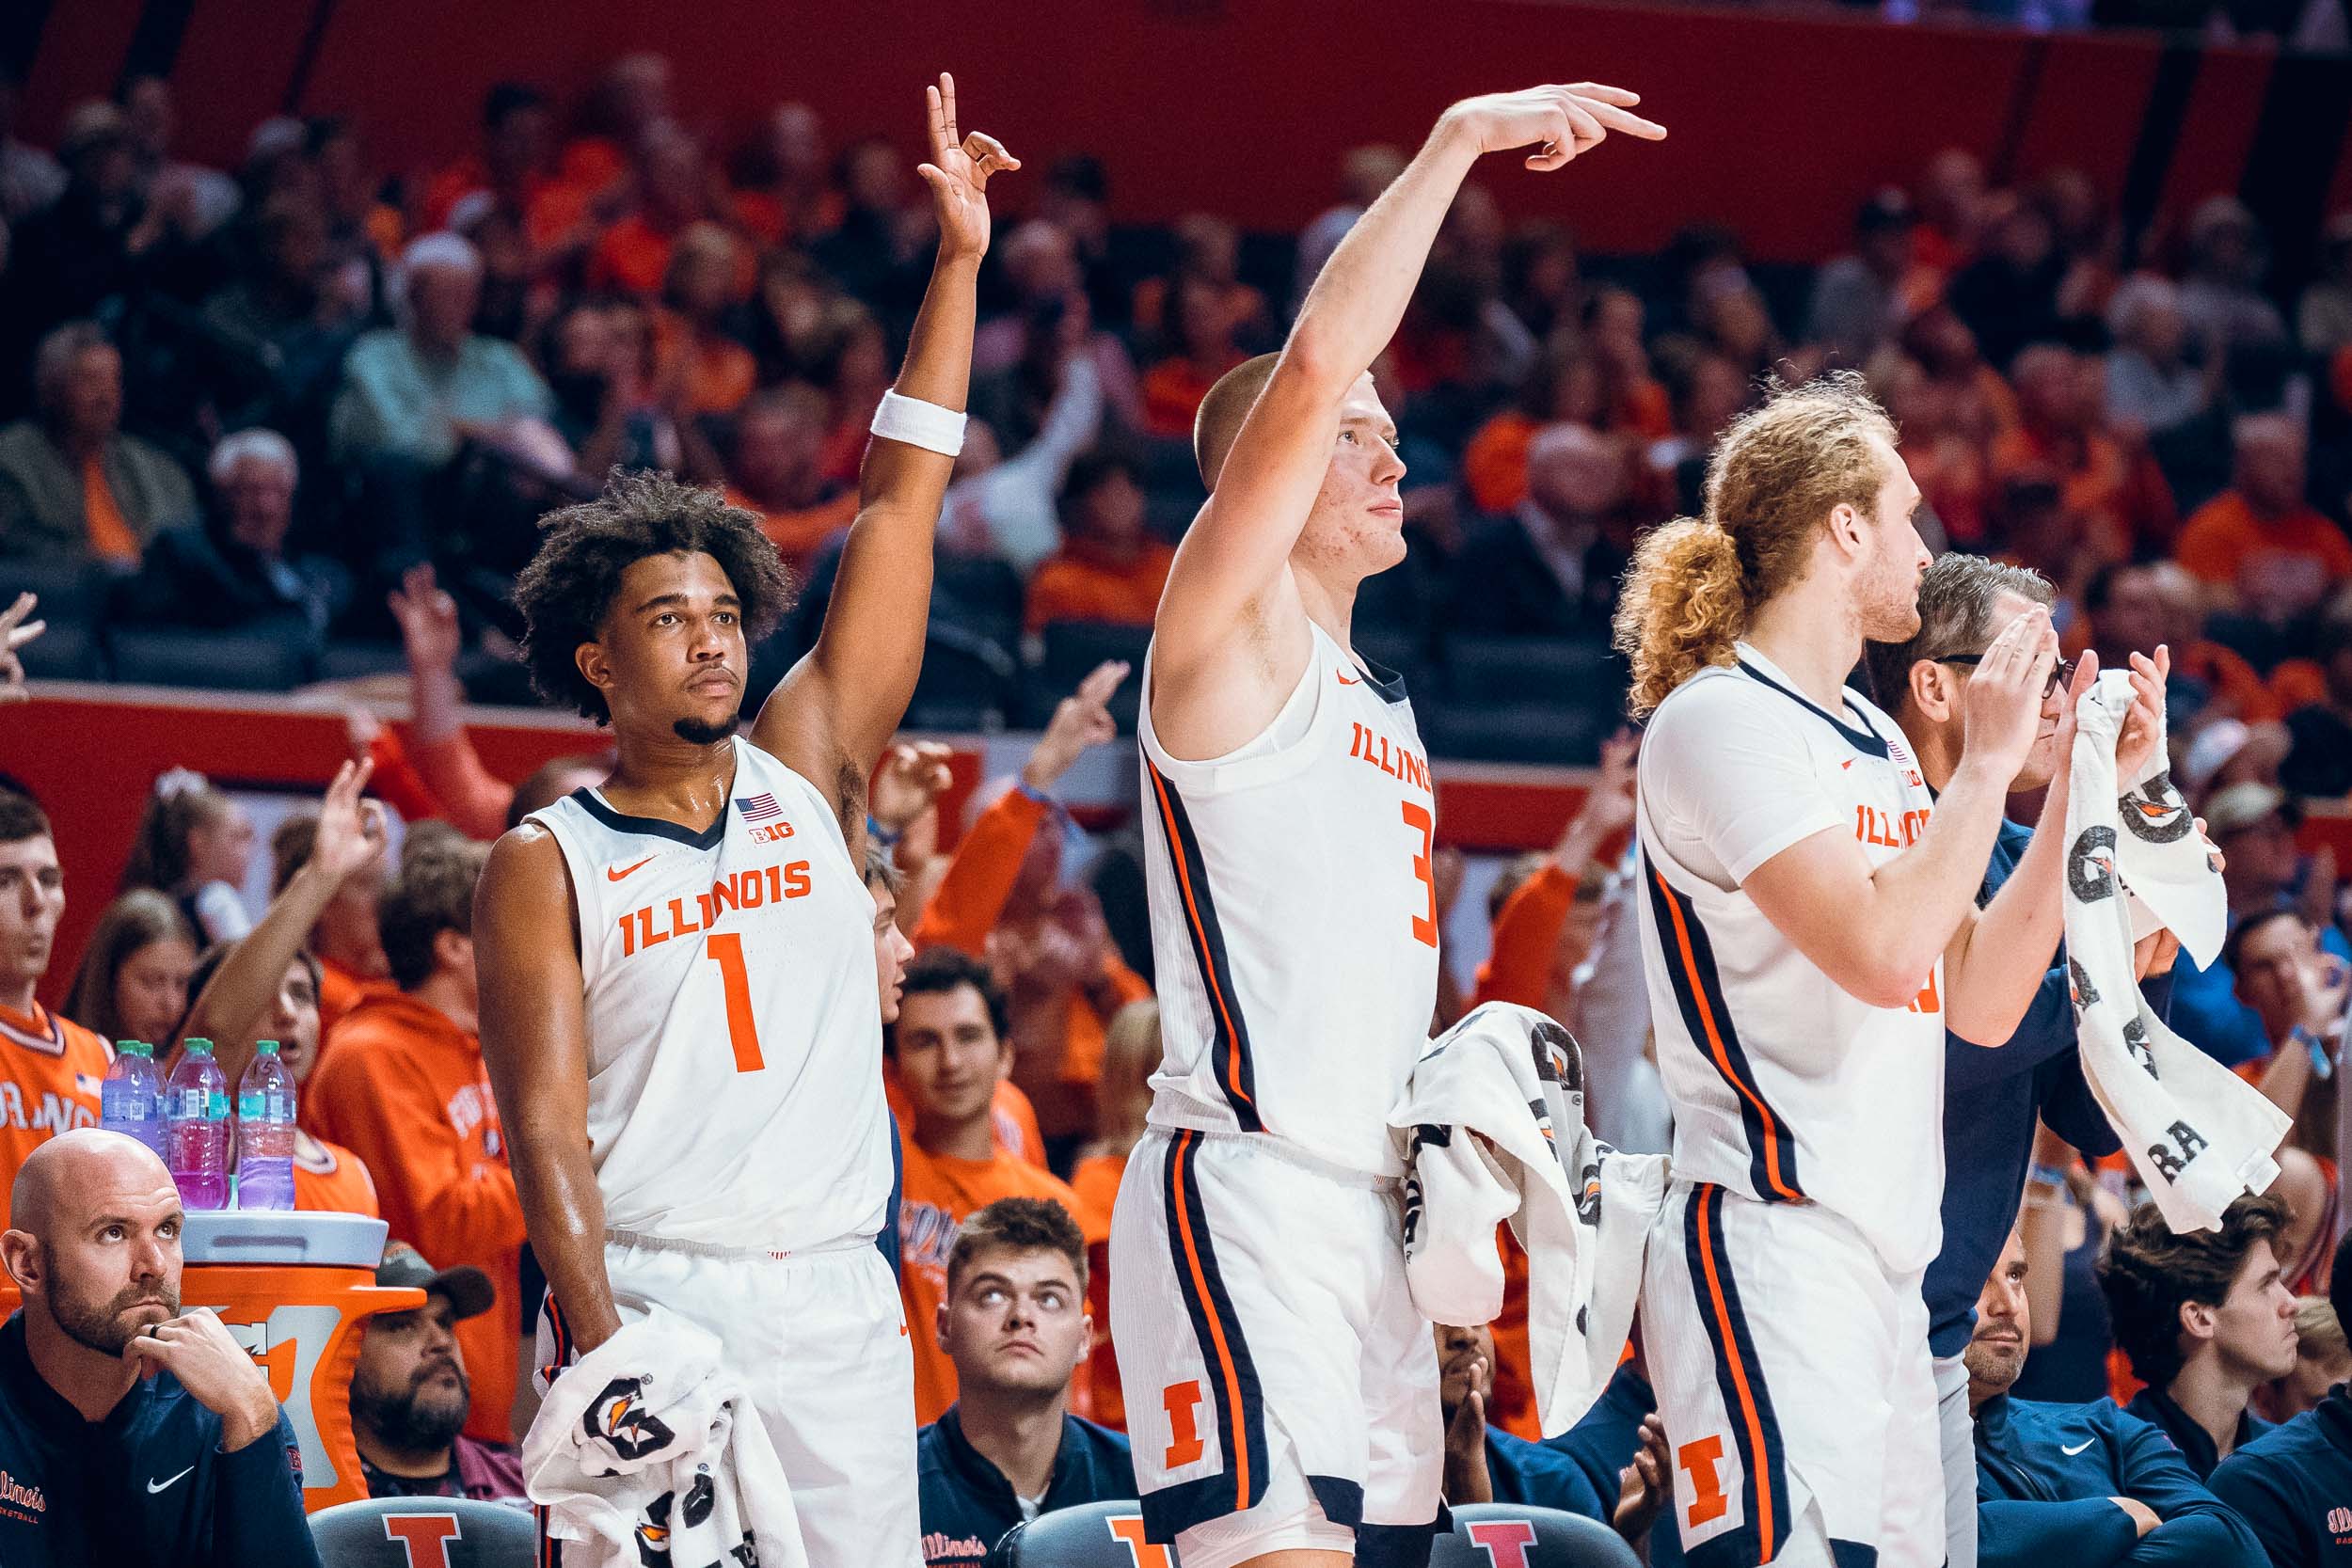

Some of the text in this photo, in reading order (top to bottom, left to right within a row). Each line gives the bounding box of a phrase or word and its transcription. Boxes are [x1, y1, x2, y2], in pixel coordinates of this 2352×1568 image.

[618, 860, 812, 958] ILLINOIS
[1401, 800, 1438, 948] 3
[707, 932, 765, 1073] 1
[1163, 1379, 1205, 1470] I
[0, 1470, 46, 1512] linois
[1678, 1433, 1728, 1528] I
